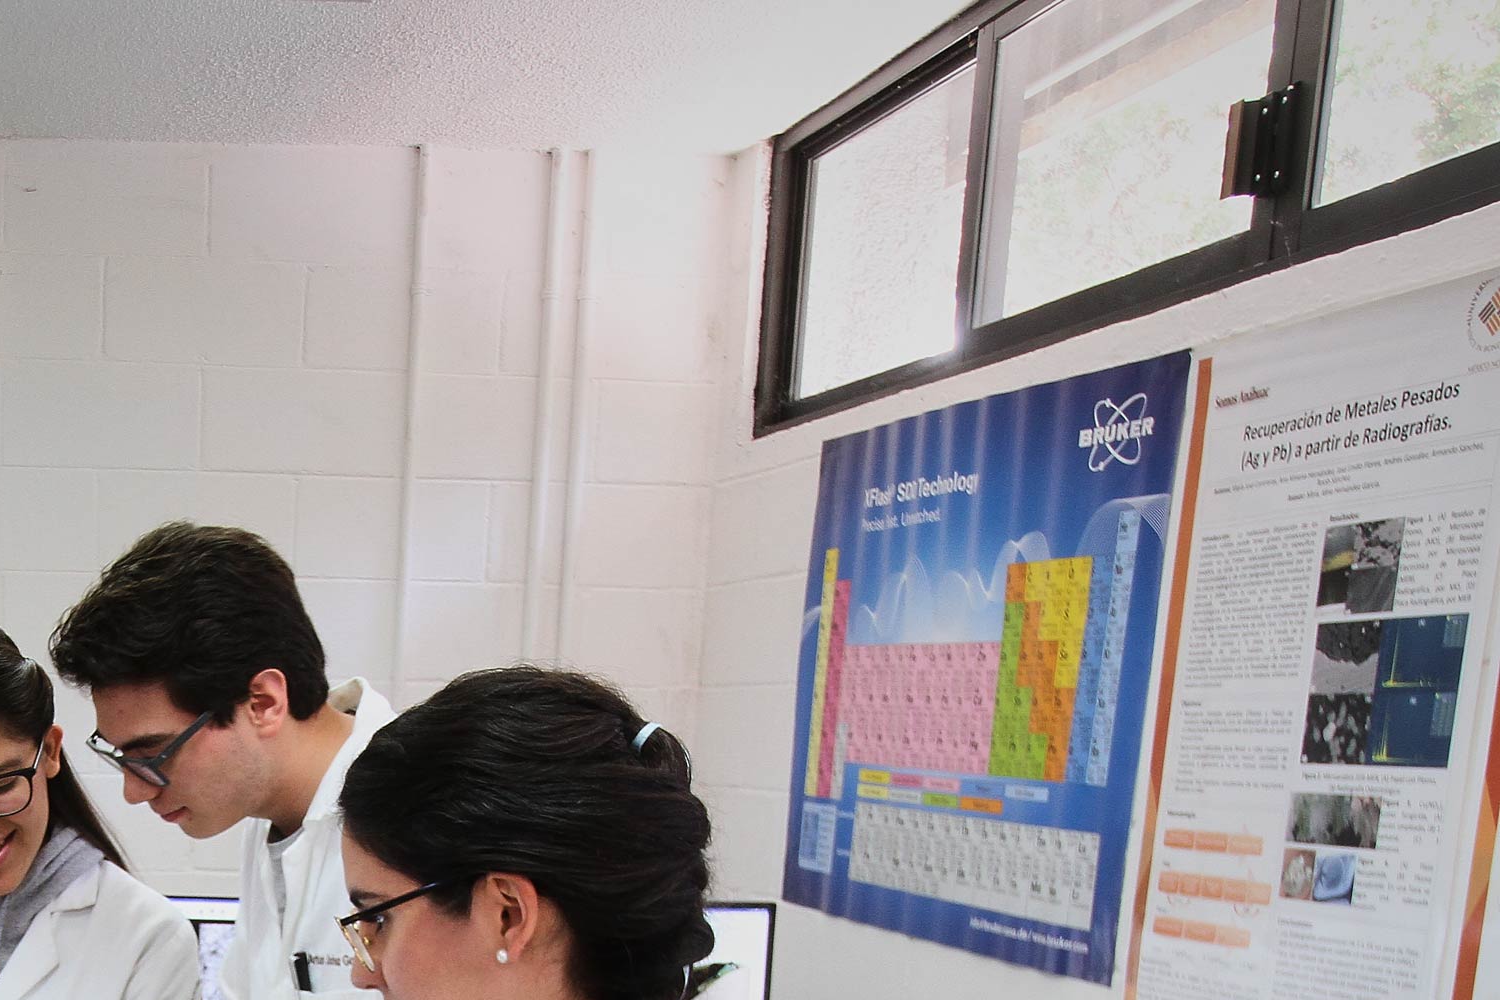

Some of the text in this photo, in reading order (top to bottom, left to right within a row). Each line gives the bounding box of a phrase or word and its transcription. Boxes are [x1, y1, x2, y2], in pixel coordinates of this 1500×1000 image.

[1079, 416, 1155, 448] BRUKER
[1243, 381, 1460, 441] Recuperación de Metales Pesados
[1241, 413, 1453, 472] (Ag y Pb) a partir de Radiografías.
